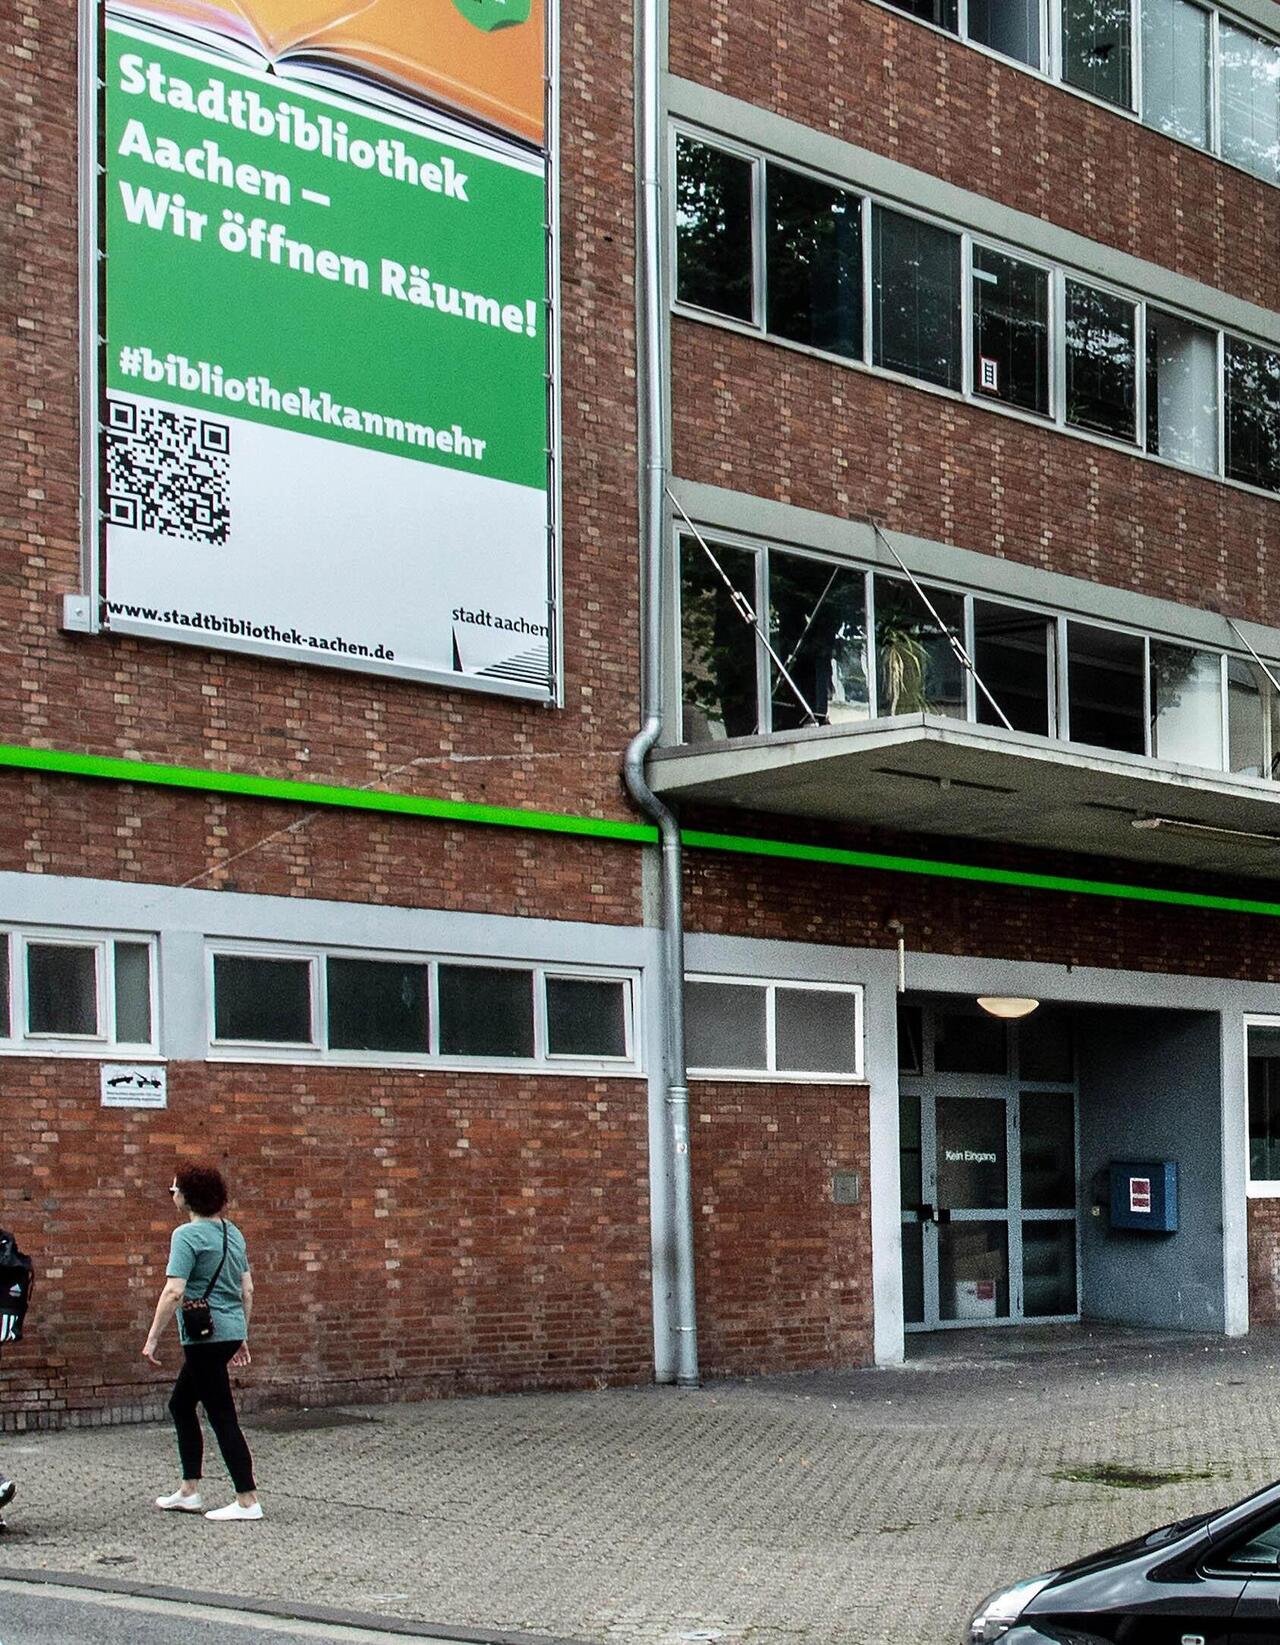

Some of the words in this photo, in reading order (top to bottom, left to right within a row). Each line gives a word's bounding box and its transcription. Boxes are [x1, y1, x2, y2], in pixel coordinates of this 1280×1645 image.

[118, 53, 470, 202] Stadtbibliothek
[118, 118, 291, 206] Aachen
[118, 180, 208, 242] Wir
[218, 209, 369, 290] öffnen
[380, 258, 537, 338] Räume!
[119, 345, 487, 460] #bibliothekkannmehr
[107, 601, 395, 661] www.stadtbibliothek-aachen.de
[945, 1150, 963, 1161] Kein
[964, 1151, 997, 1163] Eingang
